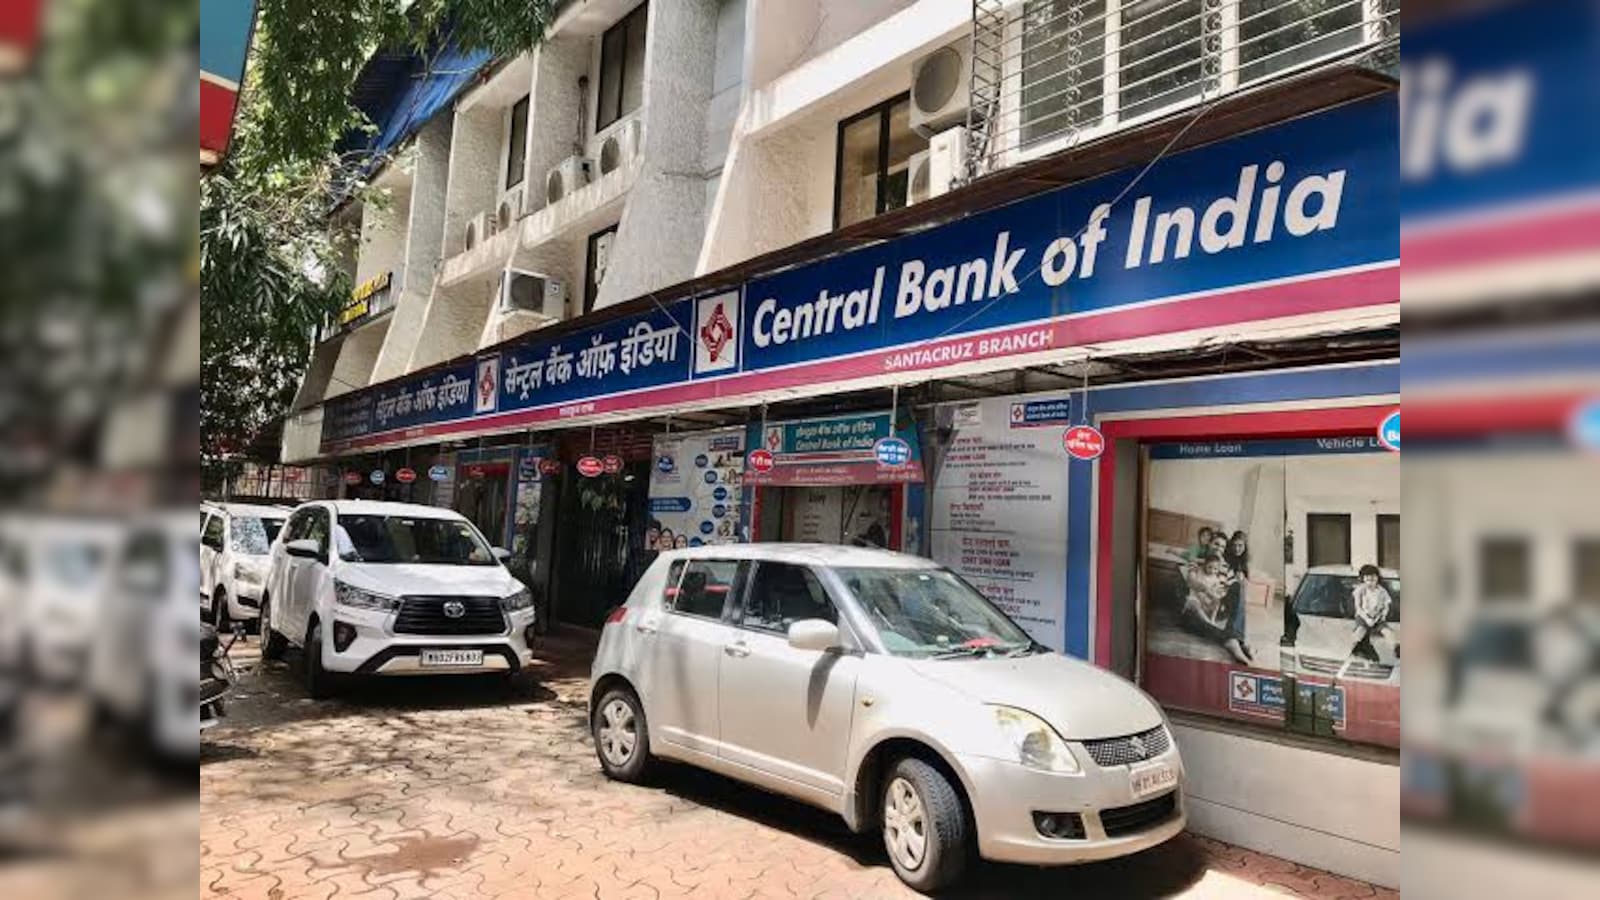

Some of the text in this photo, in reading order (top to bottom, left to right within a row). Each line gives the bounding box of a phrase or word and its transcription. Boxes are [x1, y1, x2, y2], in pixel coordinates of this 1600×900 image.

[752, 160, 1347, 348] Central Bank of India
[546, 344, 575, 386] बैंक
[620, 321, 681, 376] इंडिया
[884, 329, 1054, 370] SANTACRUZ BRANCH
[1179, 442, 1242, 454] Home Loan
[1316, 437, 1365, 450] Vehicle
